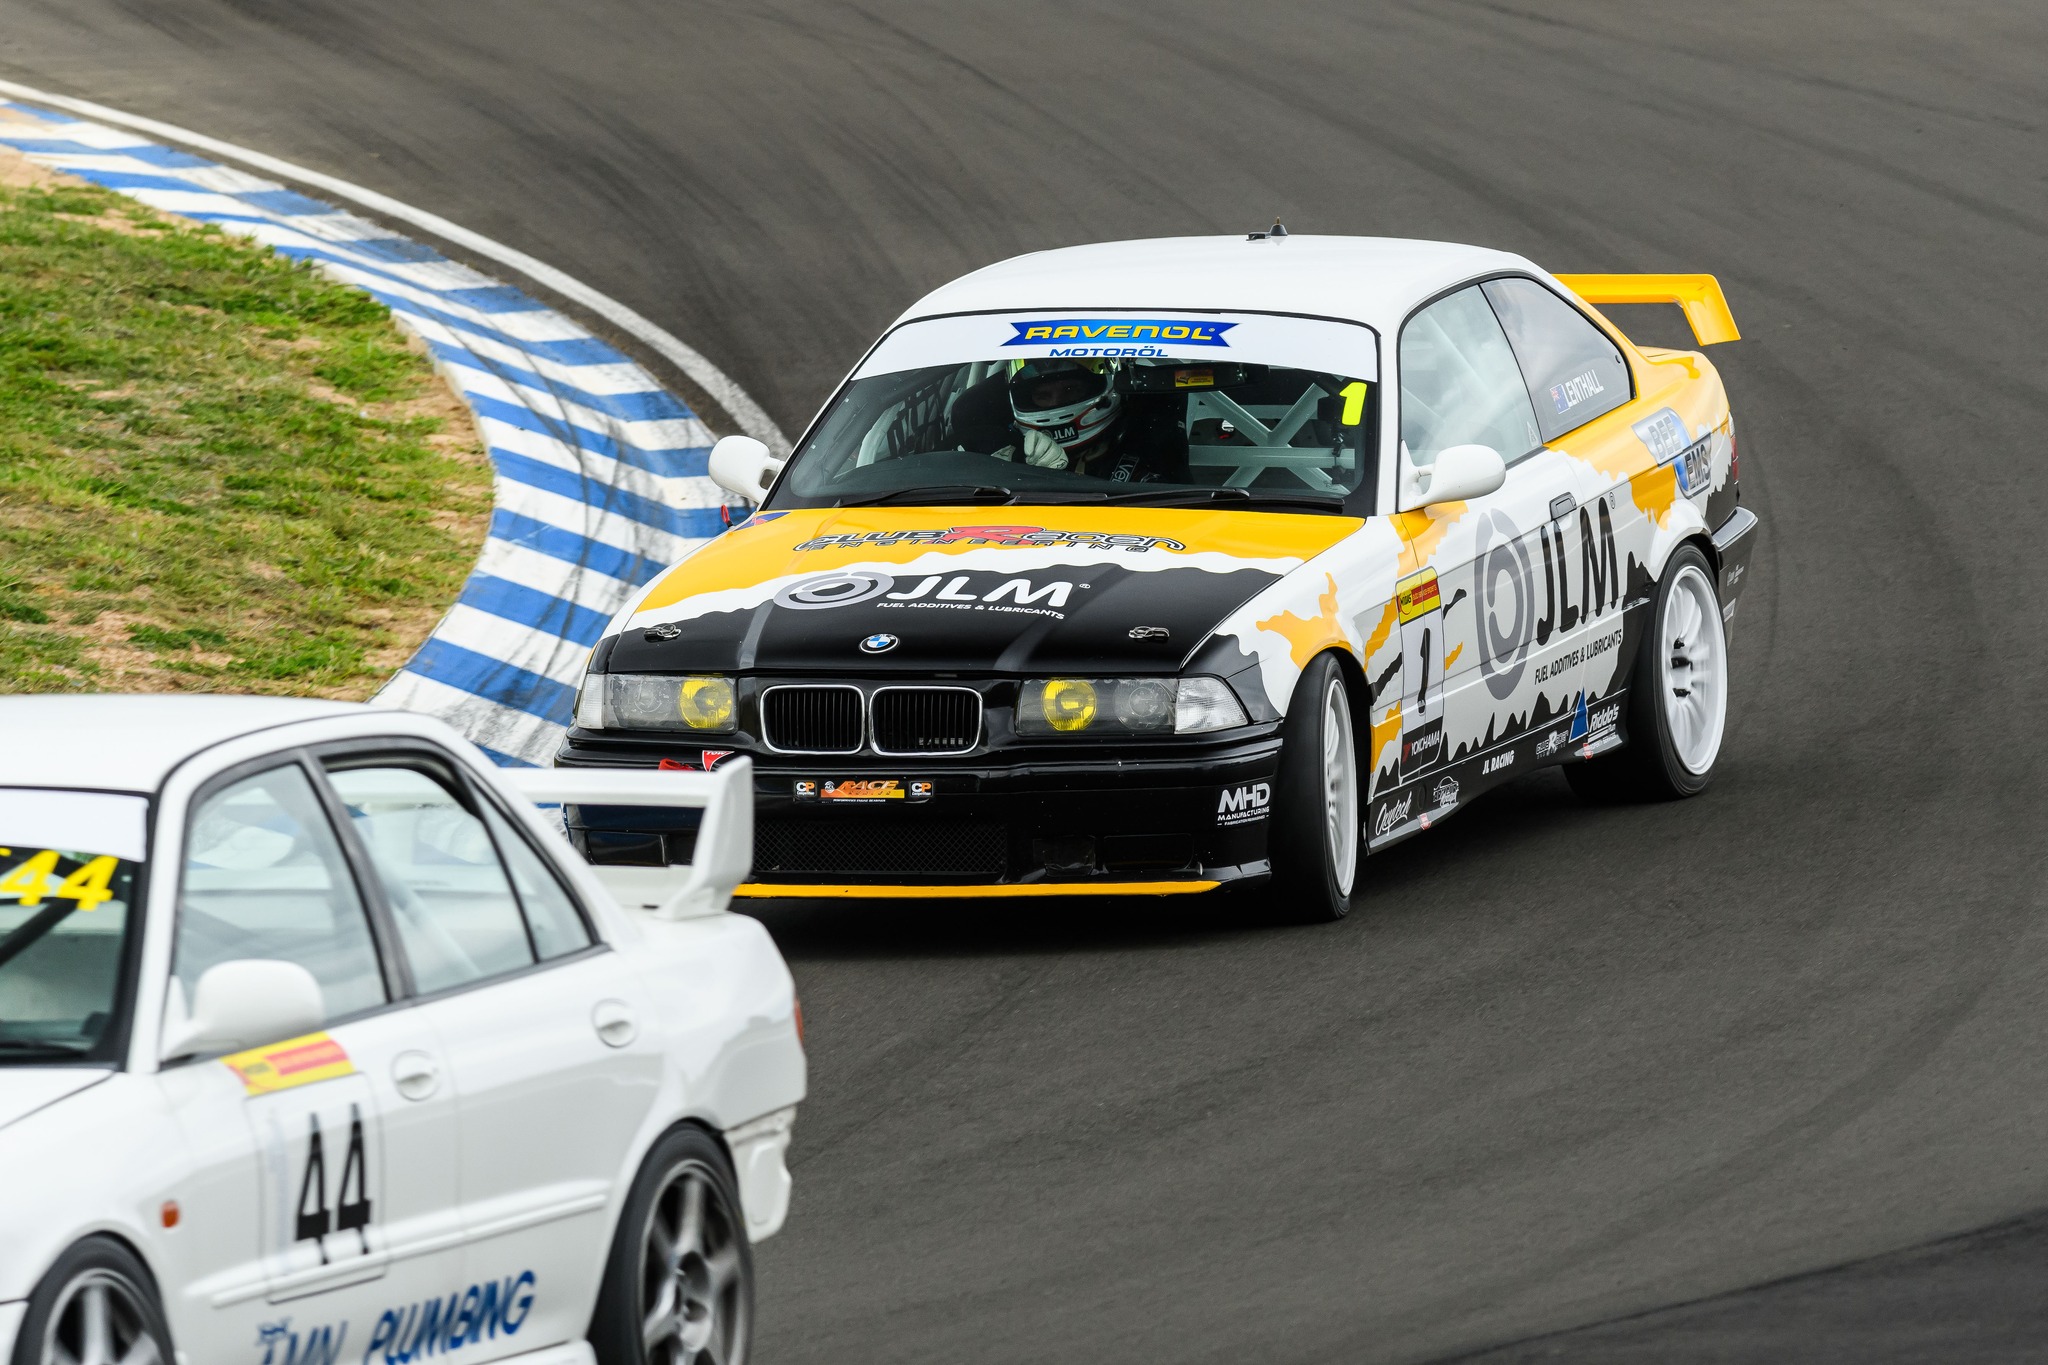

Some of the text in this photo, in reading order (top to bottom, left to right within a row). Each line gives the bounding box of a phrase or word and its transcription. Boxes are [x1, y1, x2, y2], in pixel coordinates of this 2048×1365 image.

[1025, 325, 1213, 341] RAVENOL
[1049, 345, 1169, 357] MOTORÖL
[1561, 369, 1604, 408] LENTHALL
[1339, 382, 1367, 426] 1
[1053, 426, 1076, 440] JLM
[1684, 444, 1711, 490] EMS
[1536, 496, 1619, 646] JLM
[886, 576, 1073, 607] JLM
[908, 602, 972, 610] ADDITIVES
[988, 605, 1065, 620] LUBRICANTS
[1417, 627, 1431, 714] 1
[1534, 664, 1549, 685] FUEL
[1549, 649, 1579, 678] ADDITIVES
[1586, 628, 1622, 660] LUBRICANTS
[1411, 730, 1440, 757] YOKOHAMA
[1482, 760, 1490, 775] JL
[1490, 750, 1515, 772] RACING
[796, 782, 815, 792] CP
[838, 780, 899, 790] RACE
[911, 782, 932, 793] CP
[1217, 782, 1271, 813] MHD
[1217, 806, 1270, 821] MANUFACTURING
[294, 1101, 372, 1266] 44
[363, 1269, 536, 1365] PLUMBING
